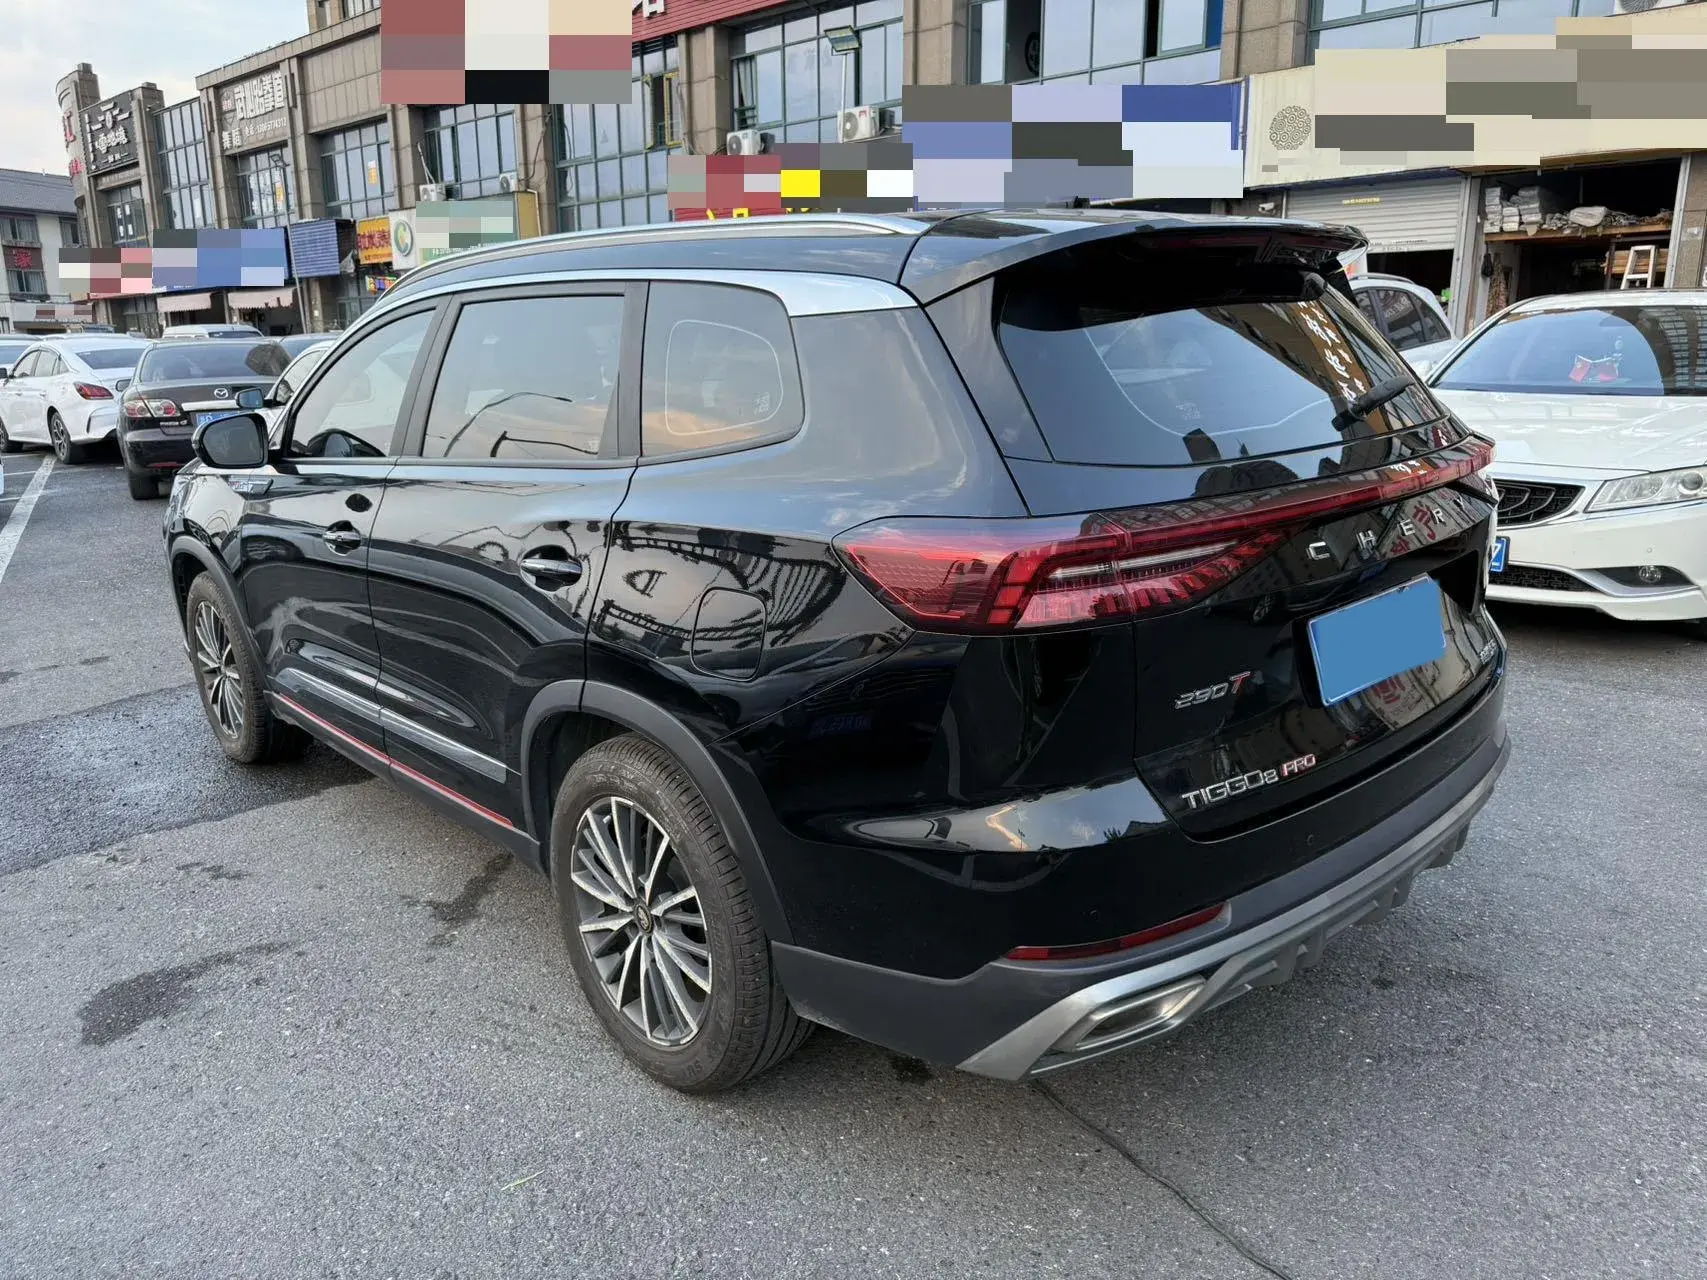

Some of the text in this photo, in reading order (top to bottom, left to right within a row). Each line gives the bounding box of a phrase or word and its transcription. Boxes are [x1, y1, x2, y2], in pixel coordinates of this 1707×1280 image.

[1306, 496, 1464, 561] CHERY
[1175, 671, 1251, 709] 290T
[1280, 754, 1316, 778] PRO
